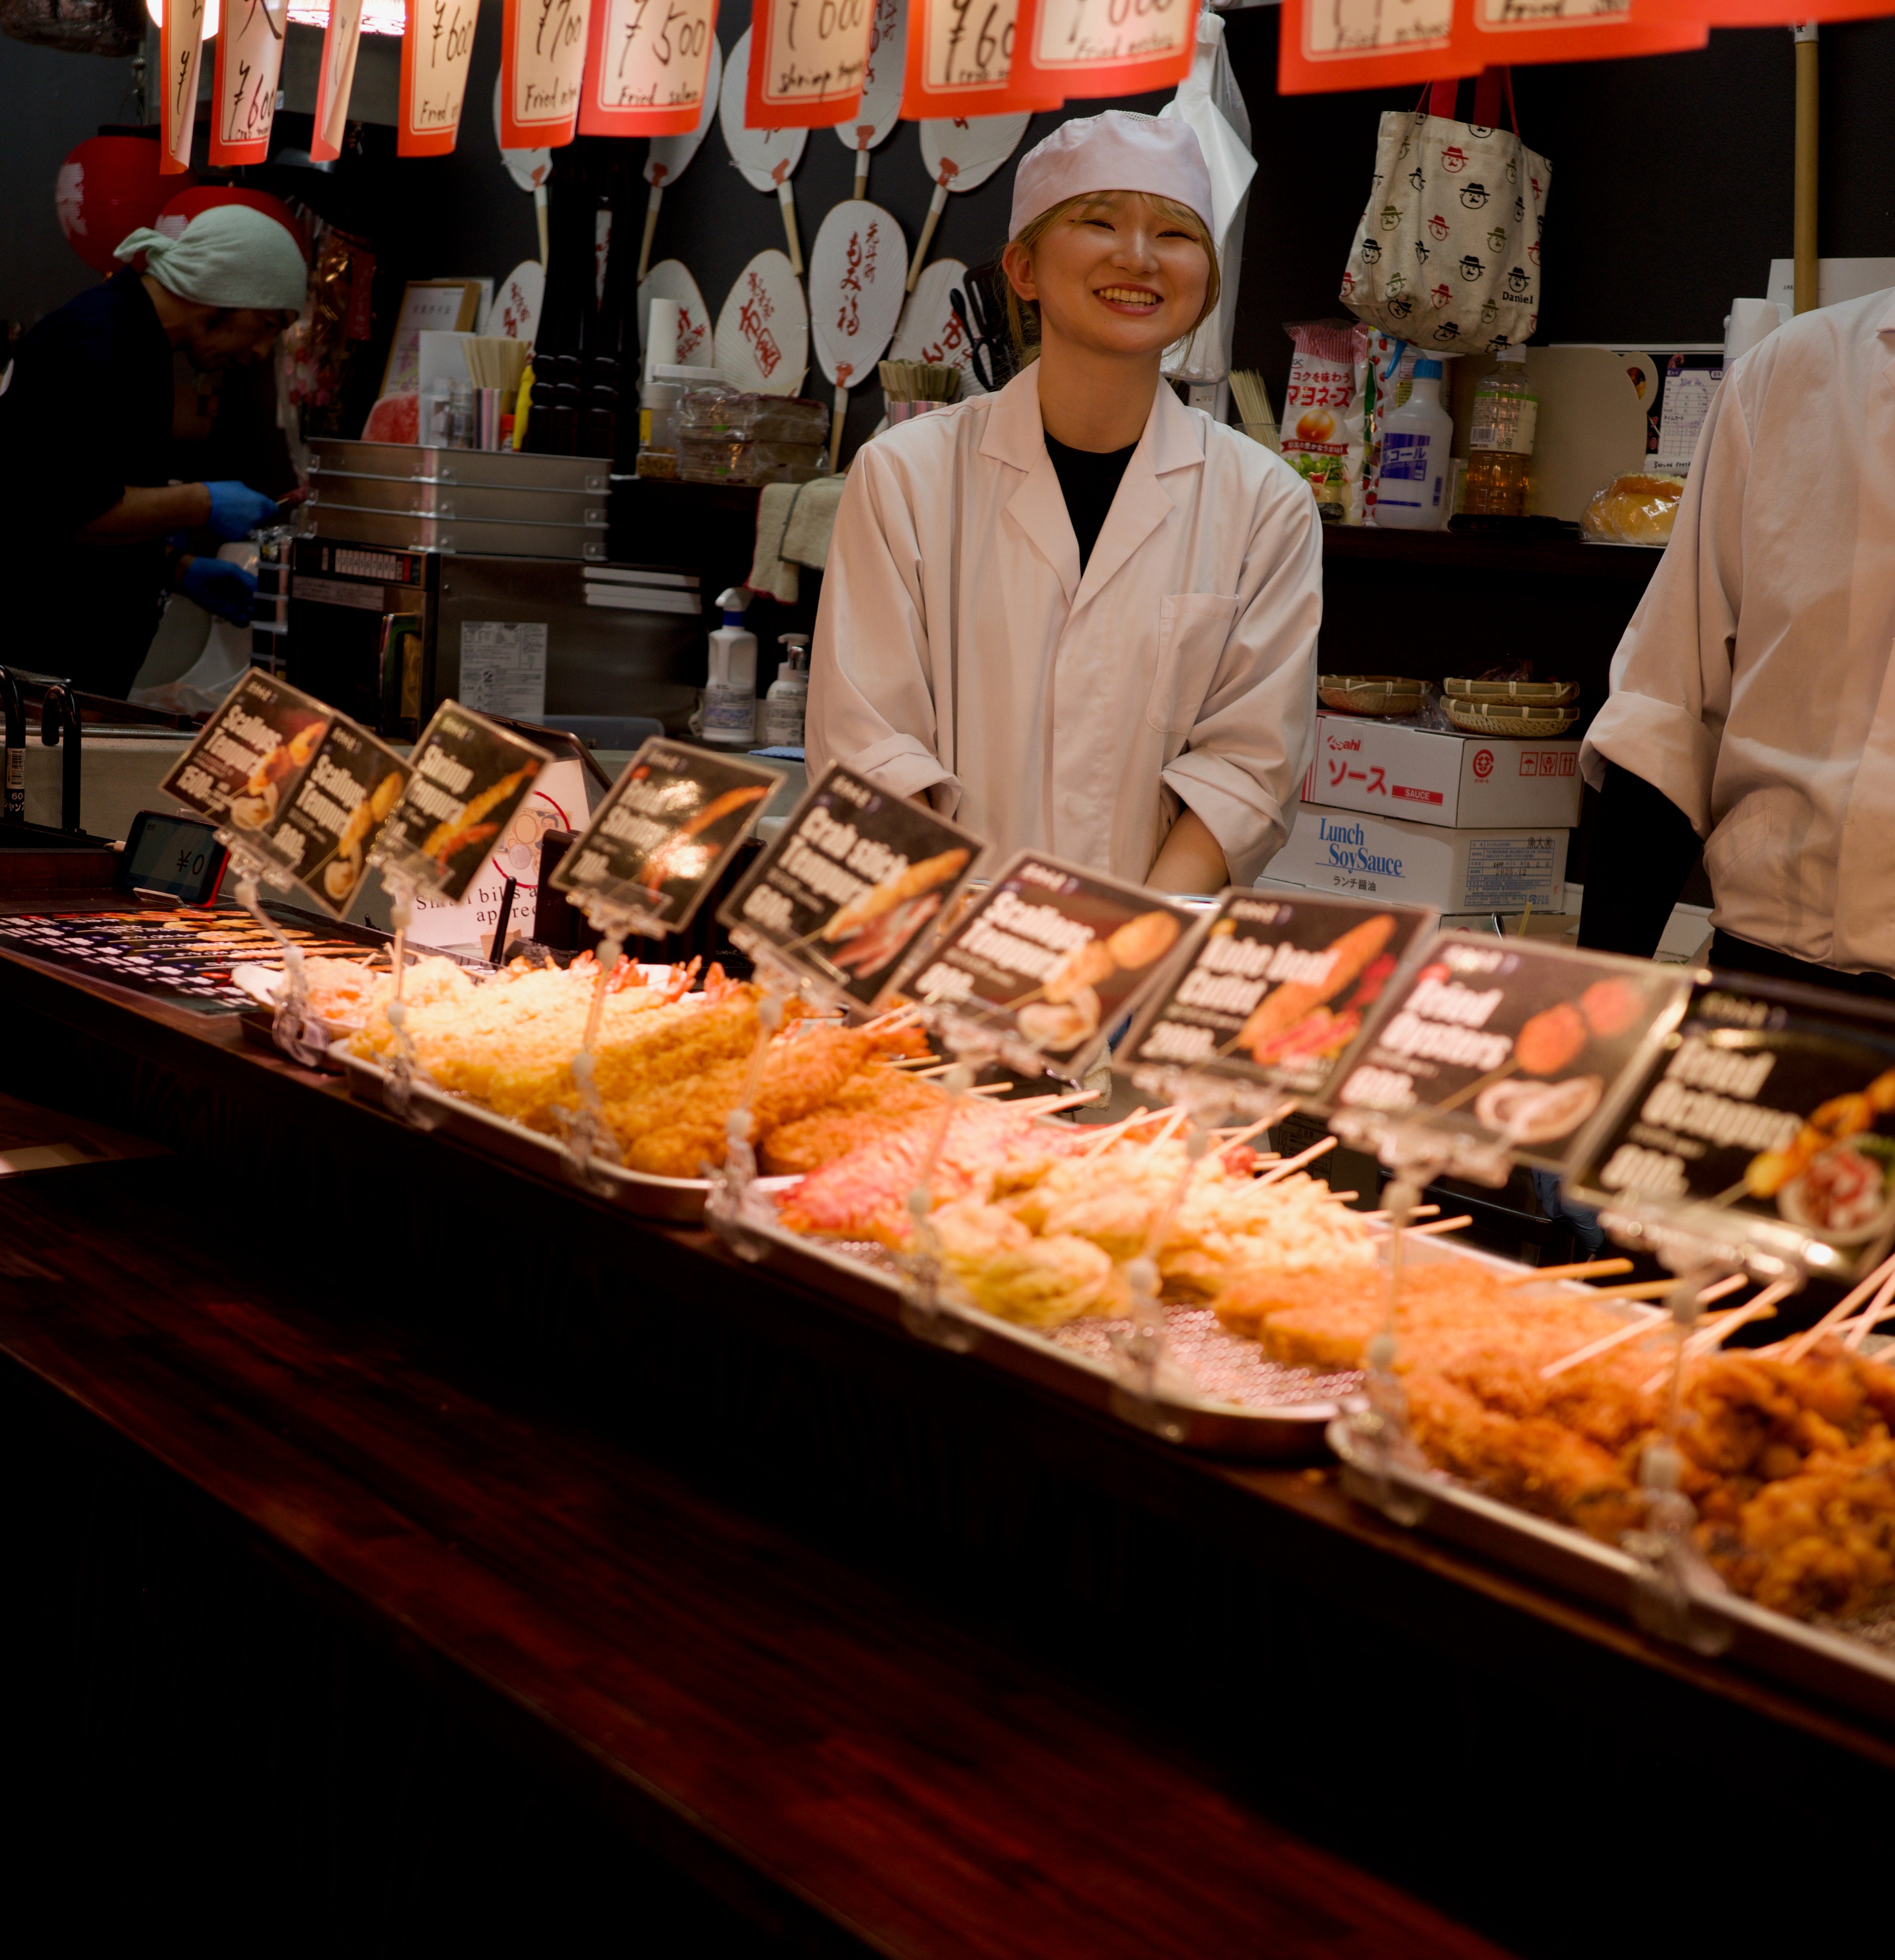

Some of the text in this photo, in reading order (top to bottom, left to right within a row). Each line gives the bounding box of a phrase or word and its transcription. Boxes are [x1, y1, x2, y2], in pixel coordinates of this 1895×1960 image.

[525, 77, 558, 112] Fried
[618, 82, 656, 106] Fried
[421, 92, 450, 124] Fried
[1502, 291, 1533, 304] Daniel
[1292, 371, 1351, 383] コクを味わう
[1287, 385, 1354, 408] マヨネーズ
[1327, 735, 1361, 751] Asahi
[1328, 758, 1387, 796] ソース
[1405, 789, 1430, 800] SAUCE
[1319, 817, 1364, 846] Lunch
[1333, 875, 1376, 892] ランチ醤油
[479, 886, 521, 905] bils
